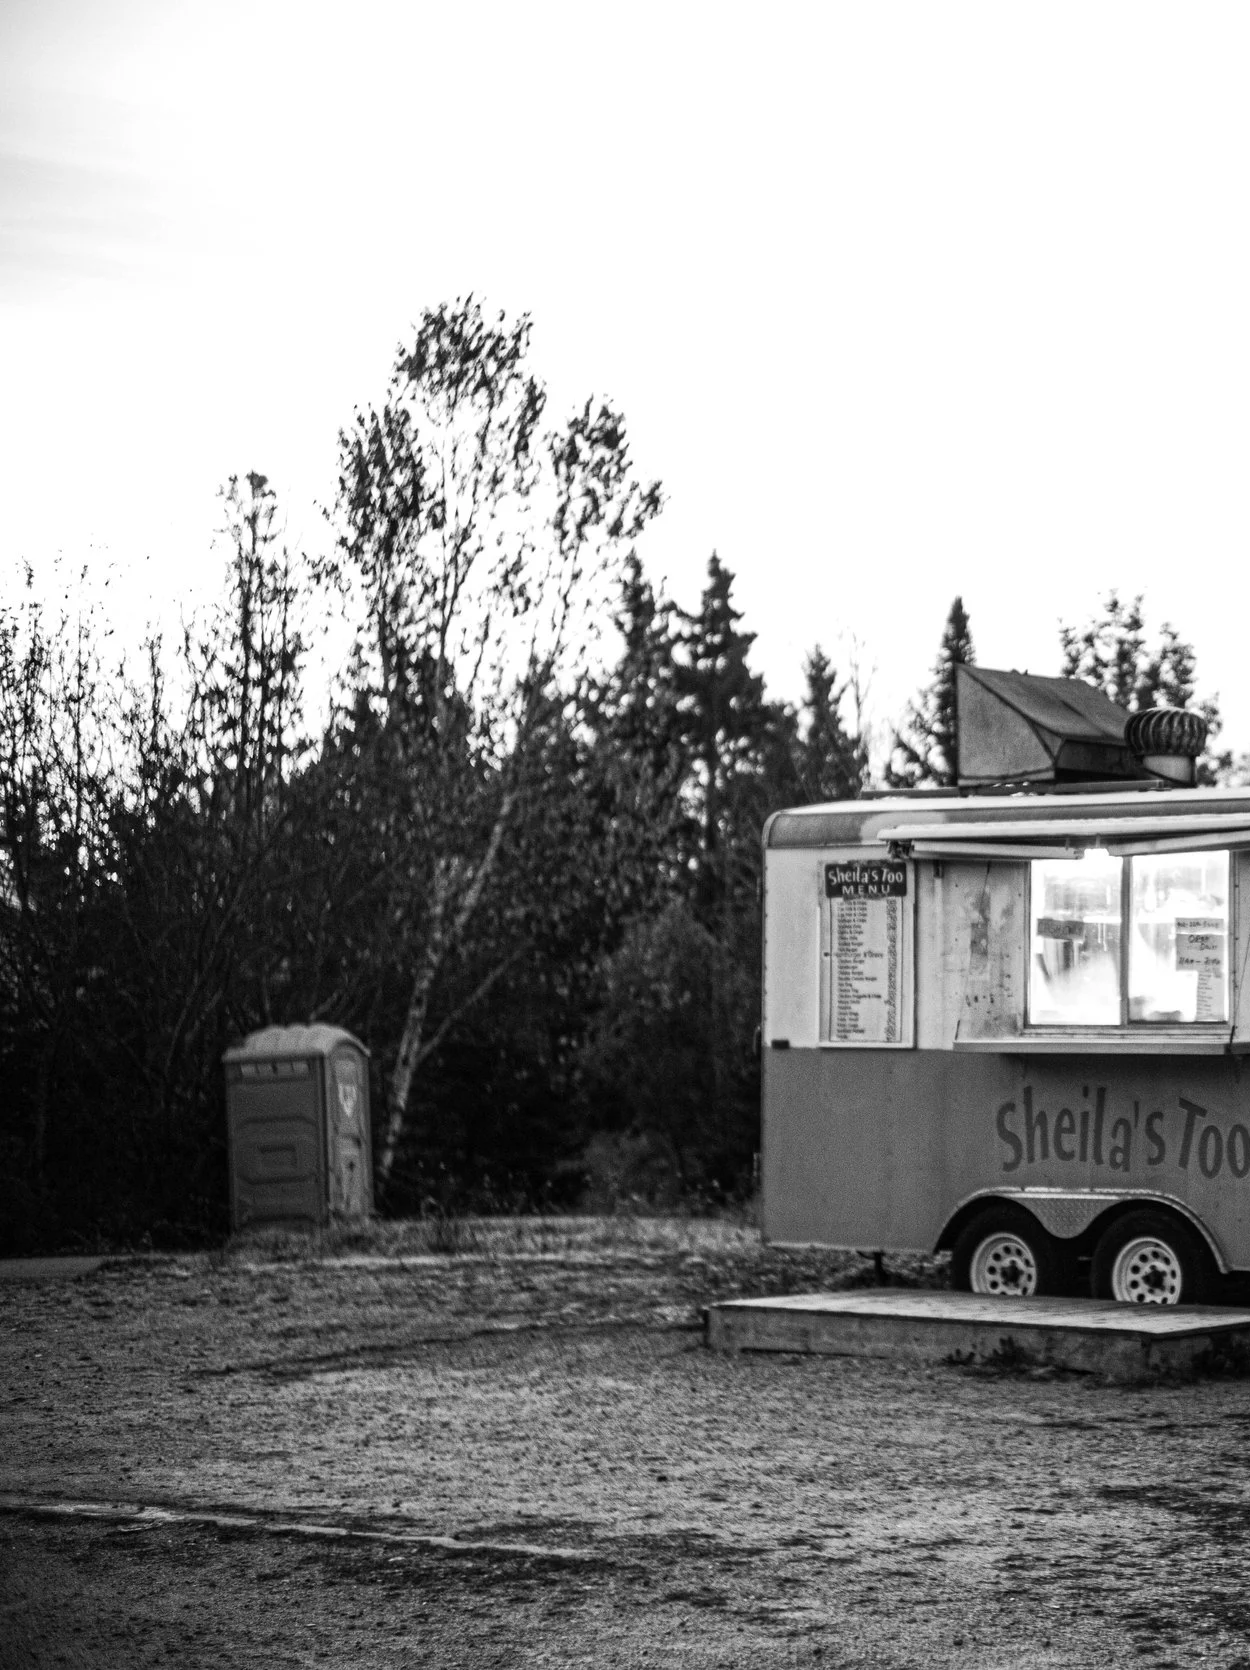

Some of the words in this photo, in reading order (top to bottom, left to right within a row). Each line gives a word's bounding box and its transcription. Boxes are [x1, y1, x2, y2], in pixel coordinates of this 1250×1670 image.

[828, 866, 879, 885] Sheila's
[881, 867, 904, 883] Too
[842, 884, 890, 895] MENU
[996, 1085, 1166, 1173] Sheila's
